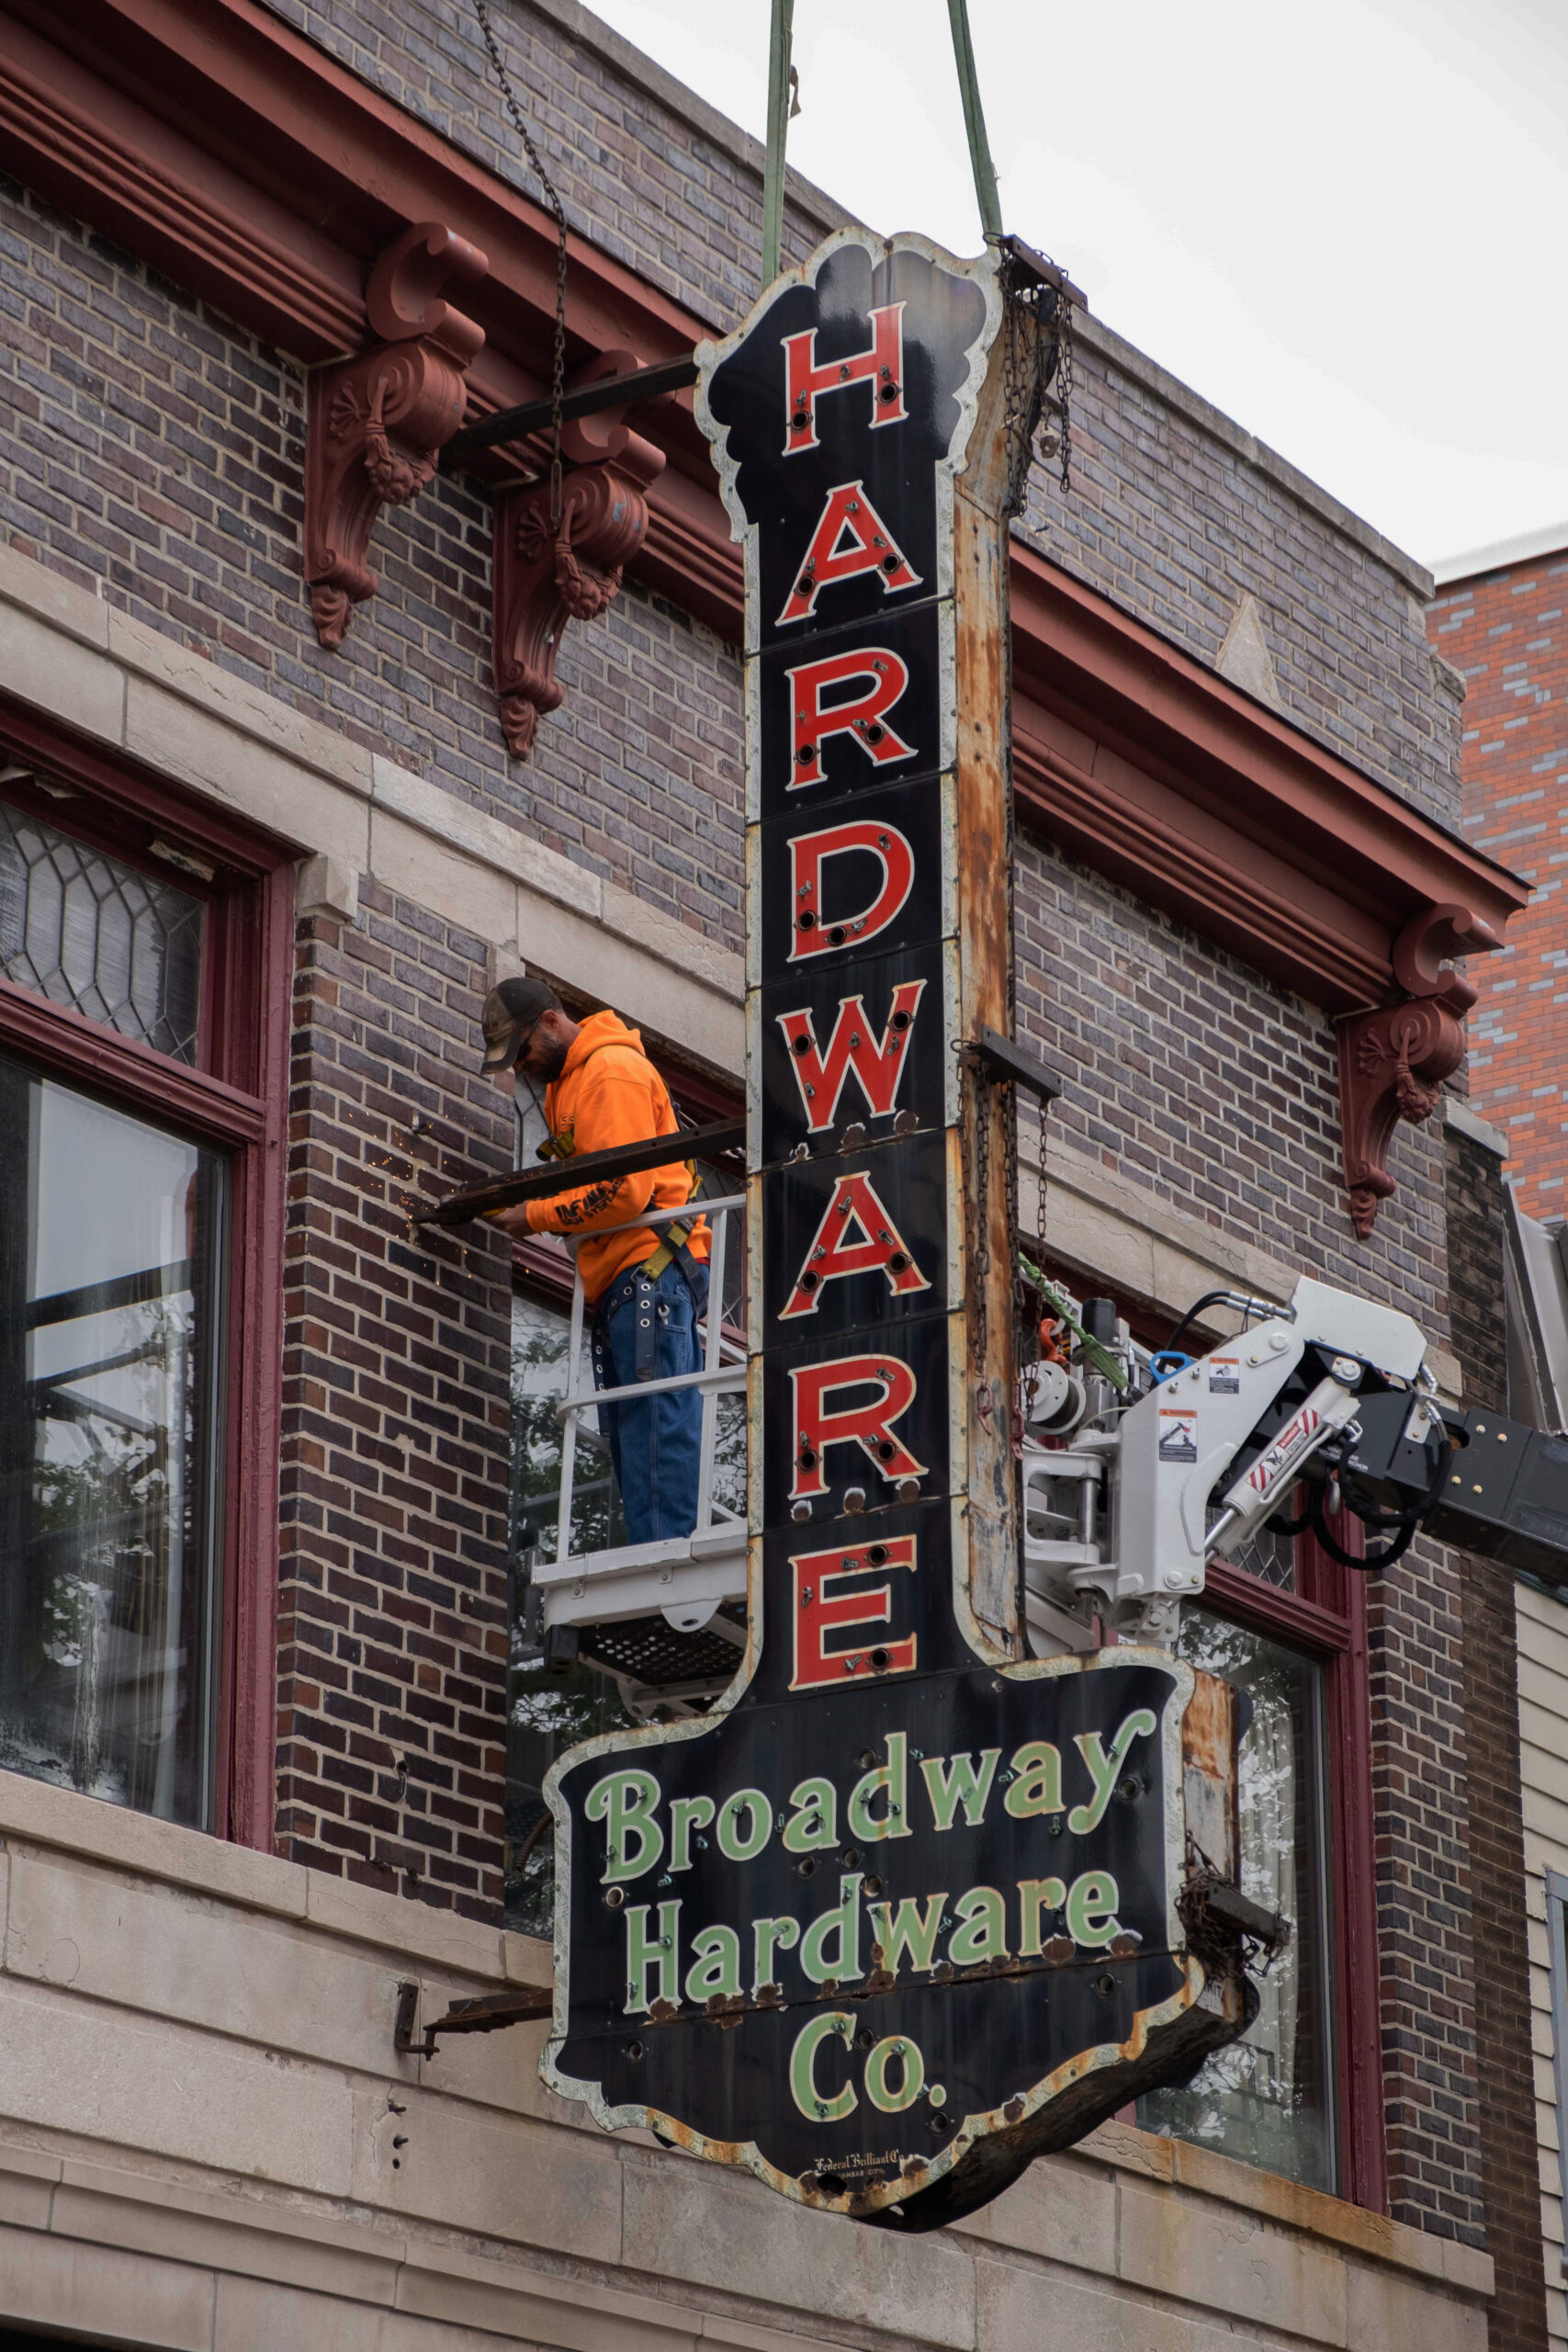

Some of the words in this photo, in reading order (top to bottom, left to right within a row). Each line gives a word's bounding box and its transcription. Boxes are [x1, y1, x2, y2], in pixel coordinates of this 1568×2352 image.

[774, 300, 931, 1691] HARDWARE
[584, 1707, 1157, 1886] Broadway
[622, 1869, 1122, 2015] Hardware
[790, 2011, 948, 2123] Co.
[814, 2154, 851, 2174] Federal
[851, 2150, 890, 2167] Brilliant
